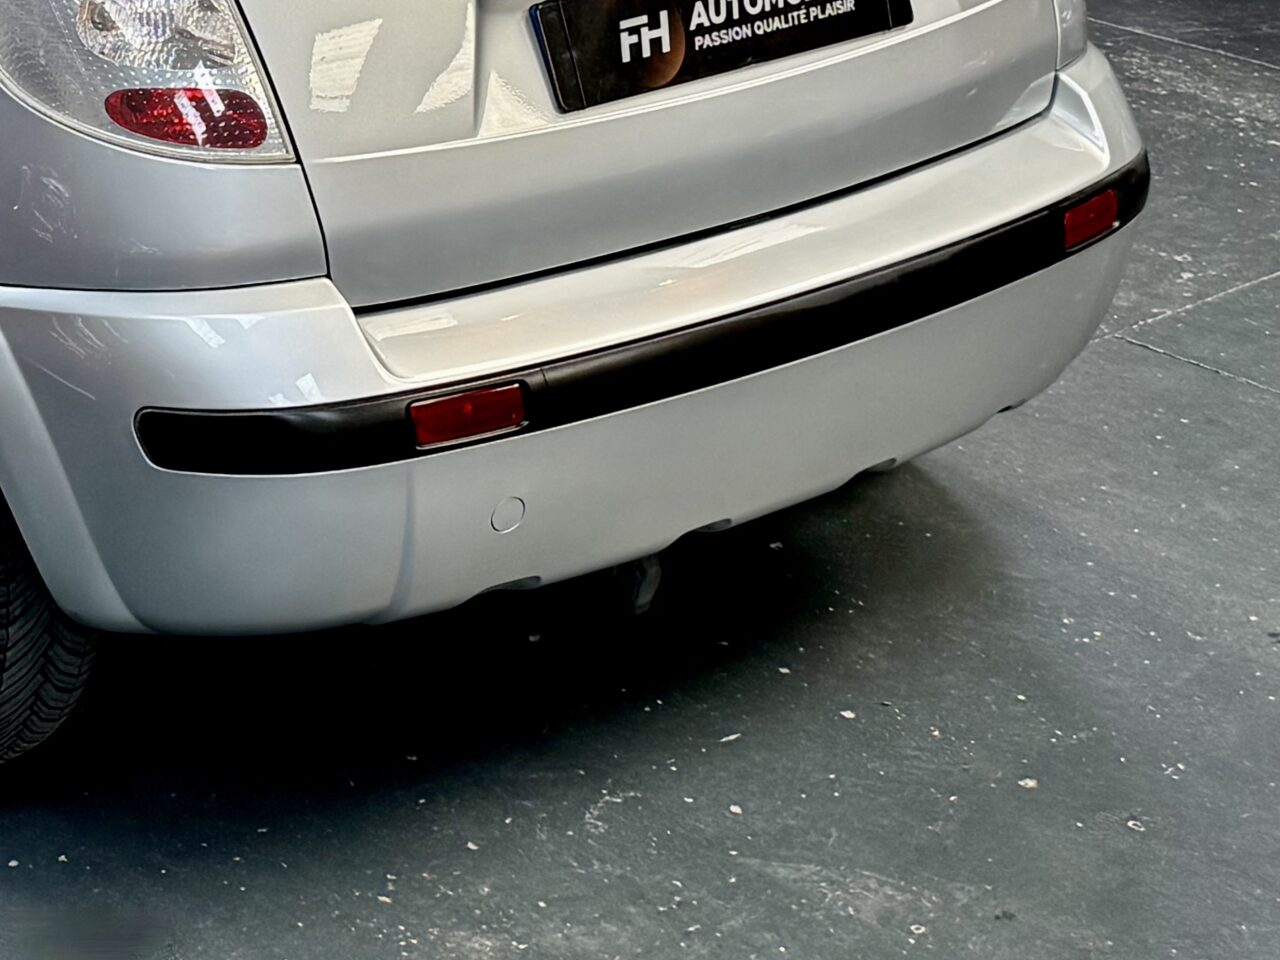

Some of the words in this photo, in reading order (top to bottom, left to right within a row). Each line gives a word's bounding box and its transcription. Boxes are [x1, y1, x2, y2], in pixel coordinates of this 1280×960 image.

[620, 9, 671, 64] FH
[694, 23, 752, 51] PASSION
[753, 5, 808, 35] QUALITÉ
